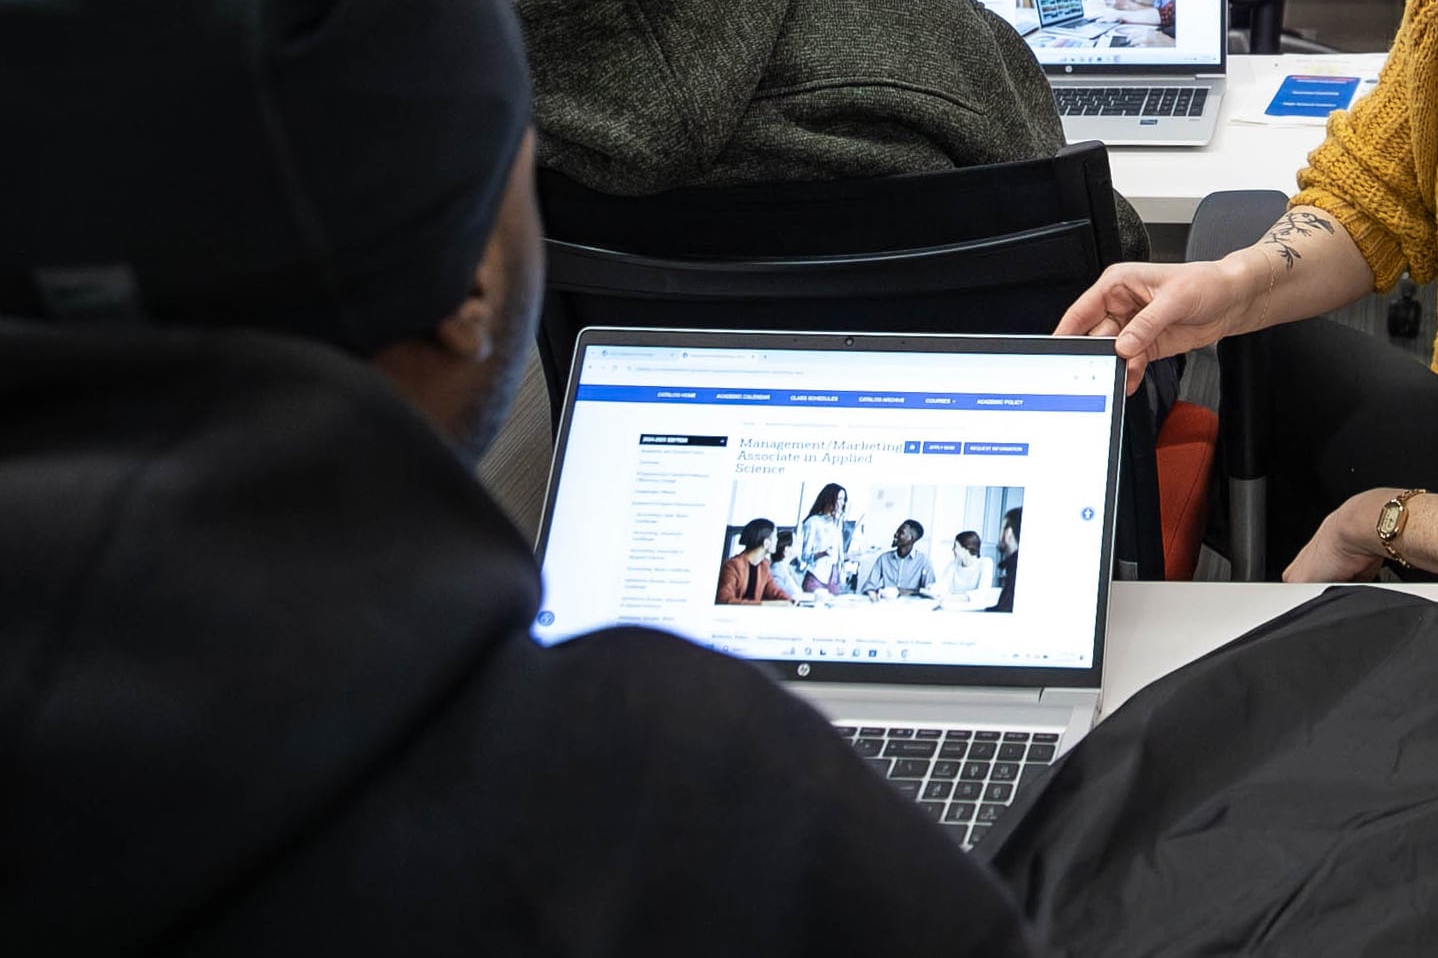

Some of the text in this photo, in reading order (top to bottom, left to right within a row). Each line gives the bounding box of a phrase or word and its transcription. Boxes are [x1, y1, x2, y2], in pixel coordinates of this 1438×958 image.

[739, 438, 904, 453] Management/Marketing
[737, 450, 873, 465] Associate in Applied
[735, 462, 786, 474] Science
